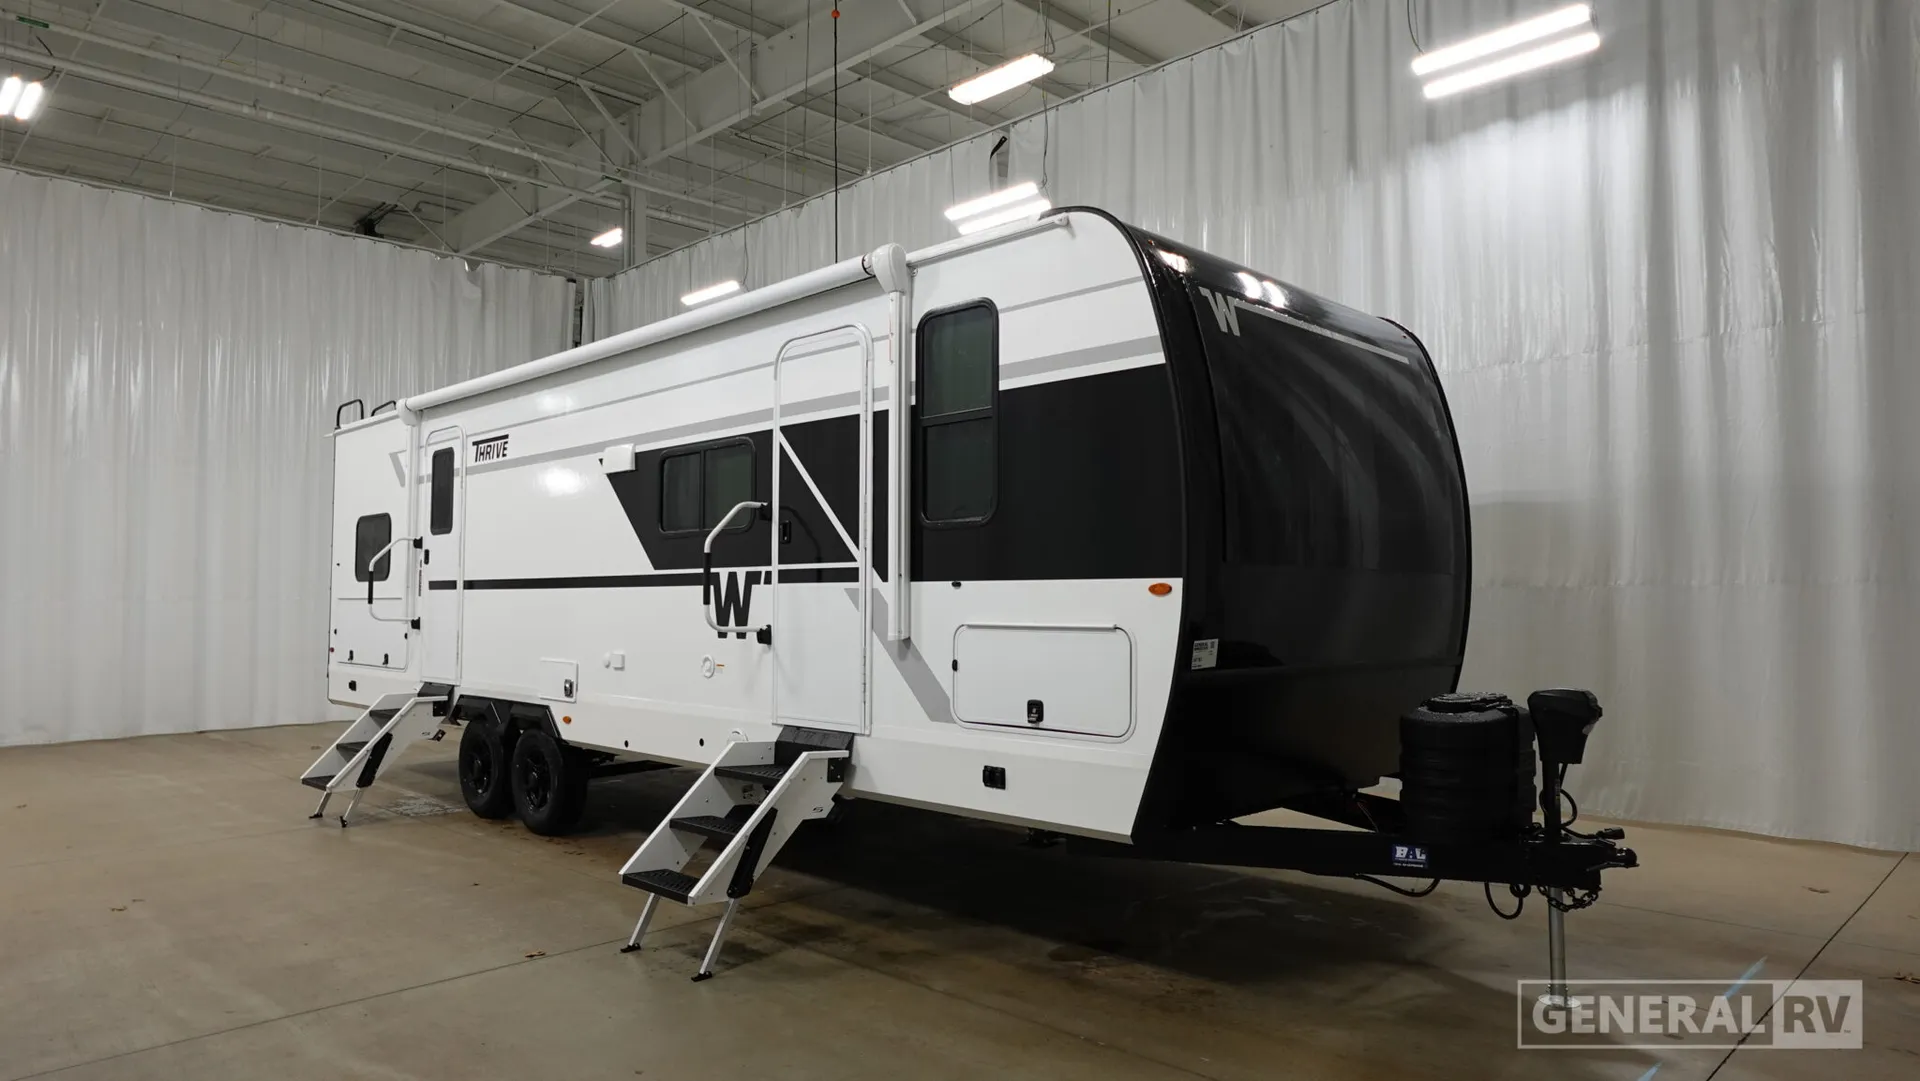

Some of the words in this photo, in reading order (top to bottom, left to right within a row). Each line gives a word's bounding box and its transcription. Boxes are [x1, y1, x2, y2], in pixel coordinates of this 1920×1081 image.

[1198, 286, 1241, 336] W
[472, 434, 509, 463] THRIVE
[705, 570, 763, 640] W
